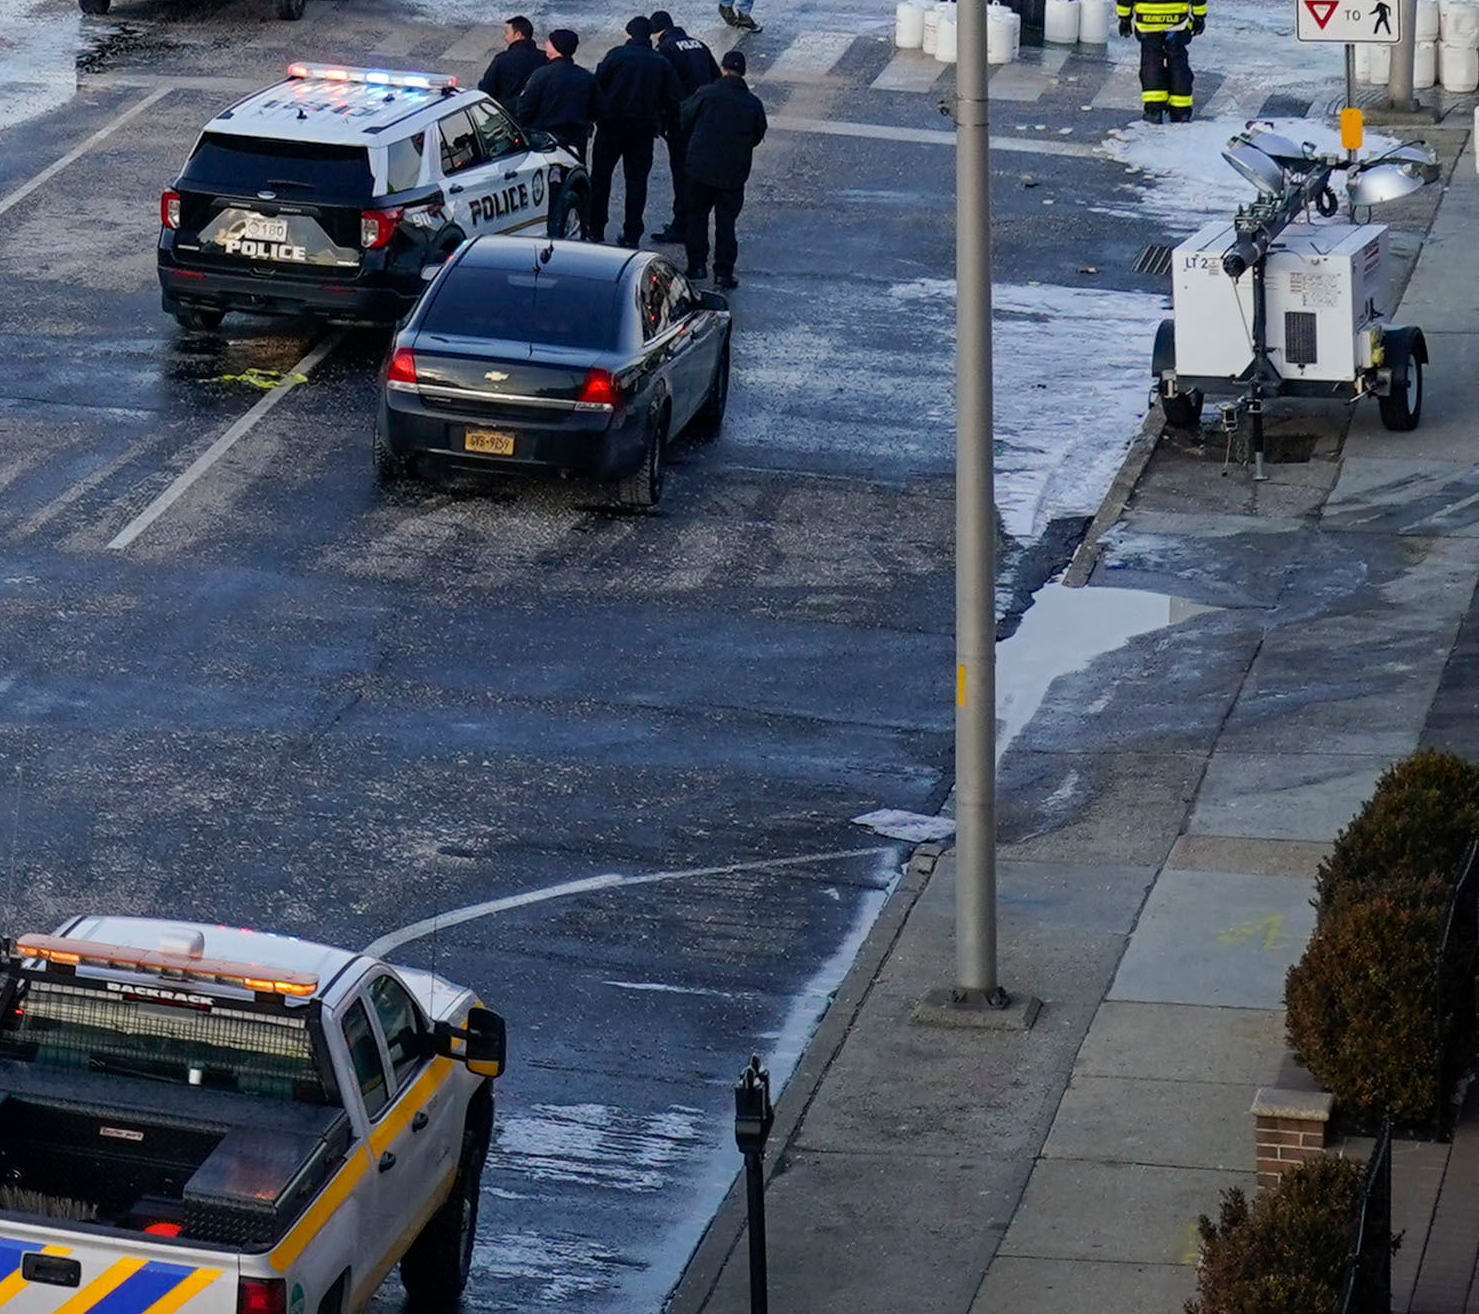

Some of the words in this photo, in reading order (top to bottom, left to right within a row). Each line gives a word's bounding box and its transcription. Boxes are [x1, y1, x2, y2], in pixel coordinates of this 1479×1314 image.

[1344, 9, 1361, 21] TO
[468, 183, 529, 227] POLICE
[225, 240, 307, 261] POLICE
[1185, 257, 1200, 269] LT
[1200, 257, 1209, 269] 2
[106, 981, 215, 1006] BACKRACK
